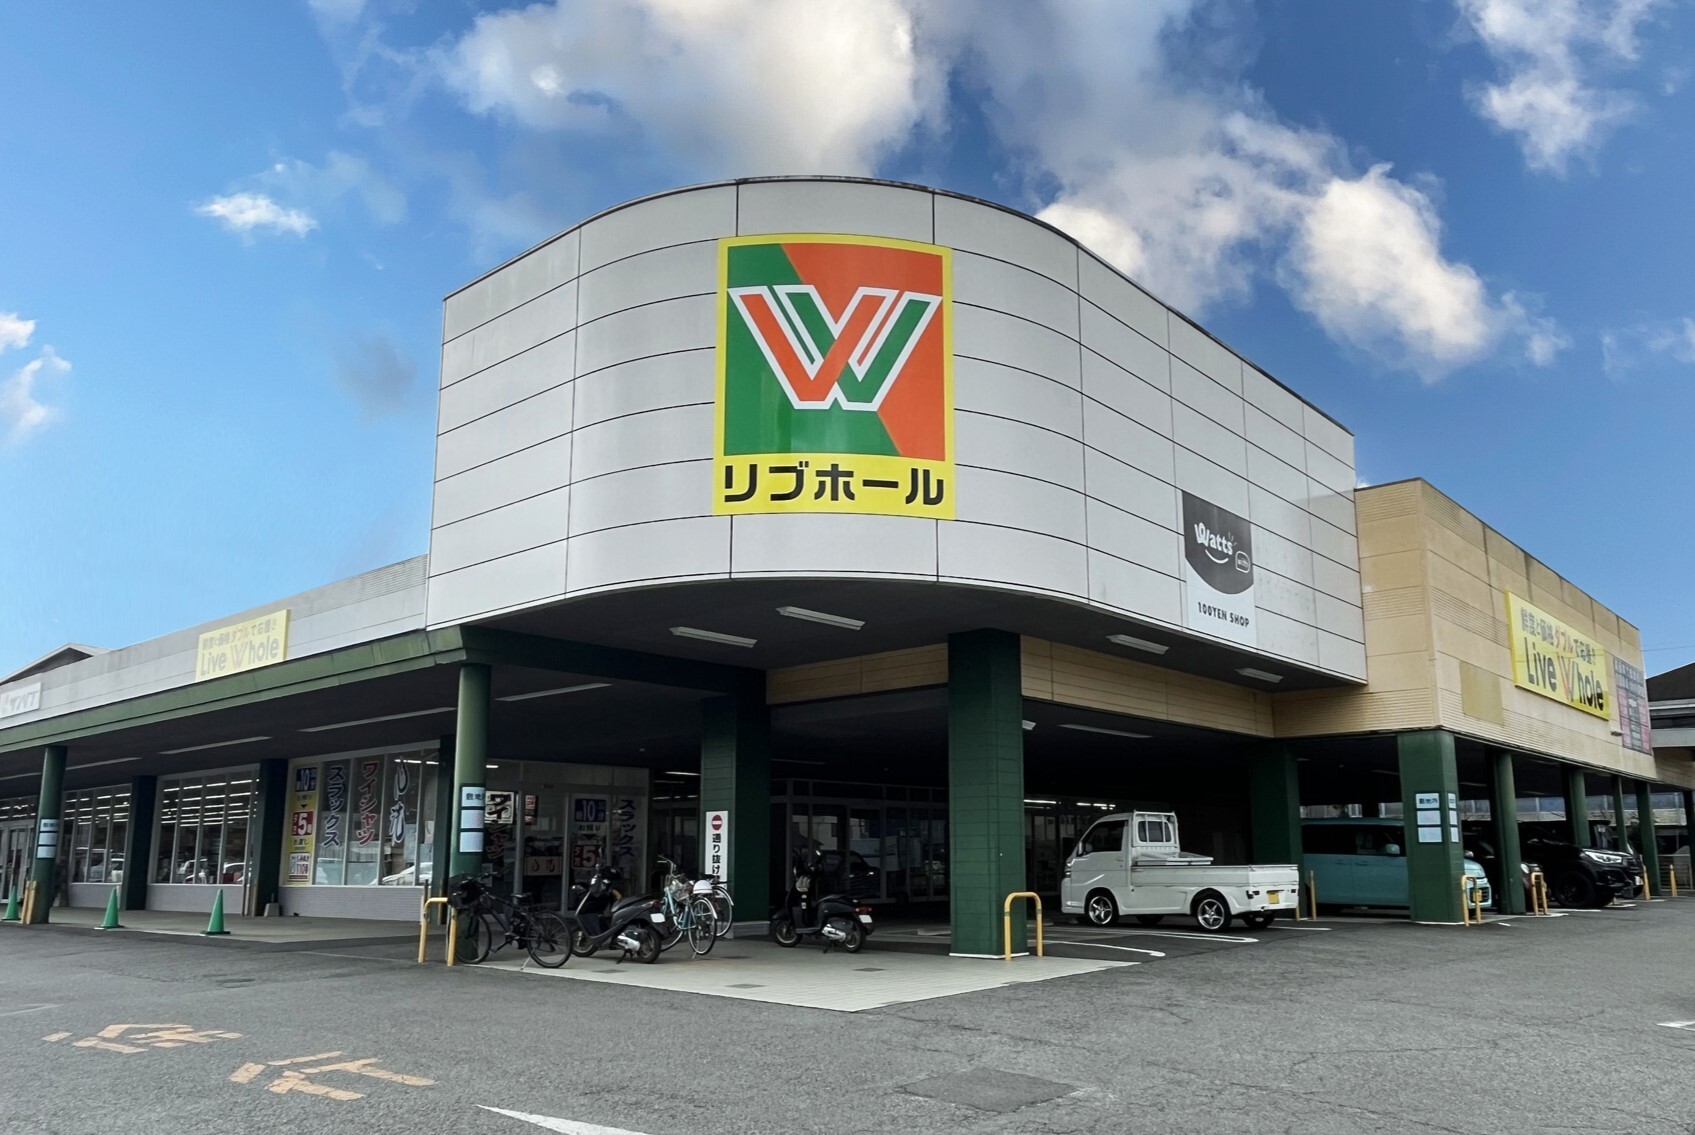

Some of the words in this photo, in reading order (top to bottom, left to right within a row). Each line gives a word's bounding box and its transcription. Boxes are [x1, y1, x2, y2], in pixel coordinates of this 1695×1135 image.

[724, 461, 944, 505] リブホール
[1194, 522, 1233, 555] Watts
[1198, 602, 1227, 621] 100YEN
[1230, 612, 1249, 627] SHOP
[201, 651, 227, 676] Live
[231, 635, 279, 670] Whole
[1524, 637, 1557, 692] Live
[1556, 651, 1604, 711] Whole
[322, 765, 344, 847] スラックス
[356, 761, 378, 846] ワイシャツ
[619, 800, 636, 856] スラックス
